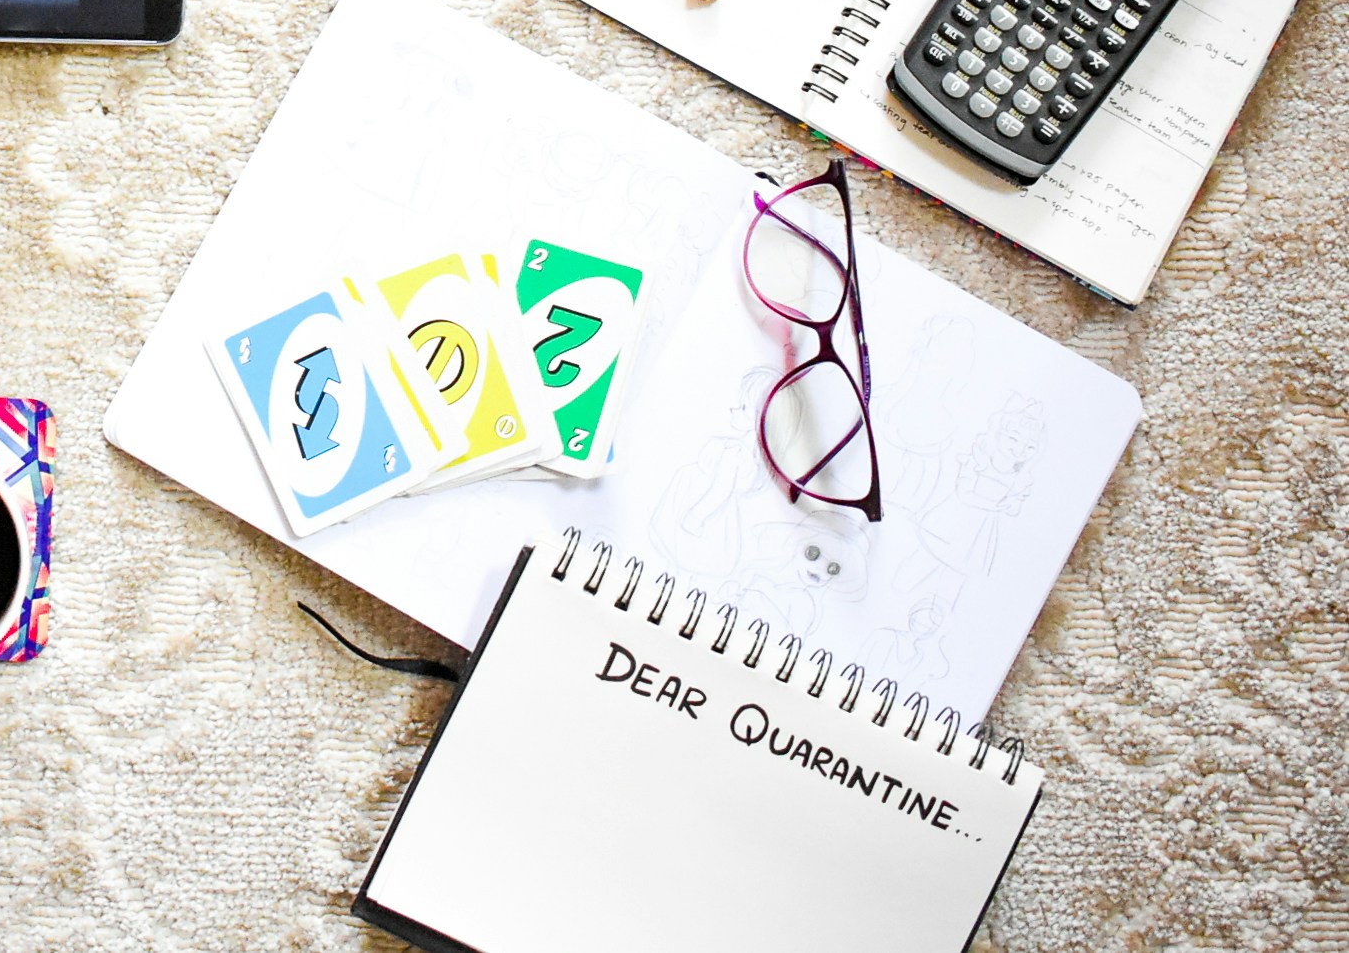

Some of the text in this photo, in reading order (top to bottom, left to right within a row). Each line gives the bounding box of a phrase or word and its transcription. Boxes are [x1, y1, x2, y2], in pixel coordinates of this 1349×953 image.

[527, 248, 548, 271] 2
[568, 428, 590, 452] 2
[595, 641, 708, 720] DEAR
